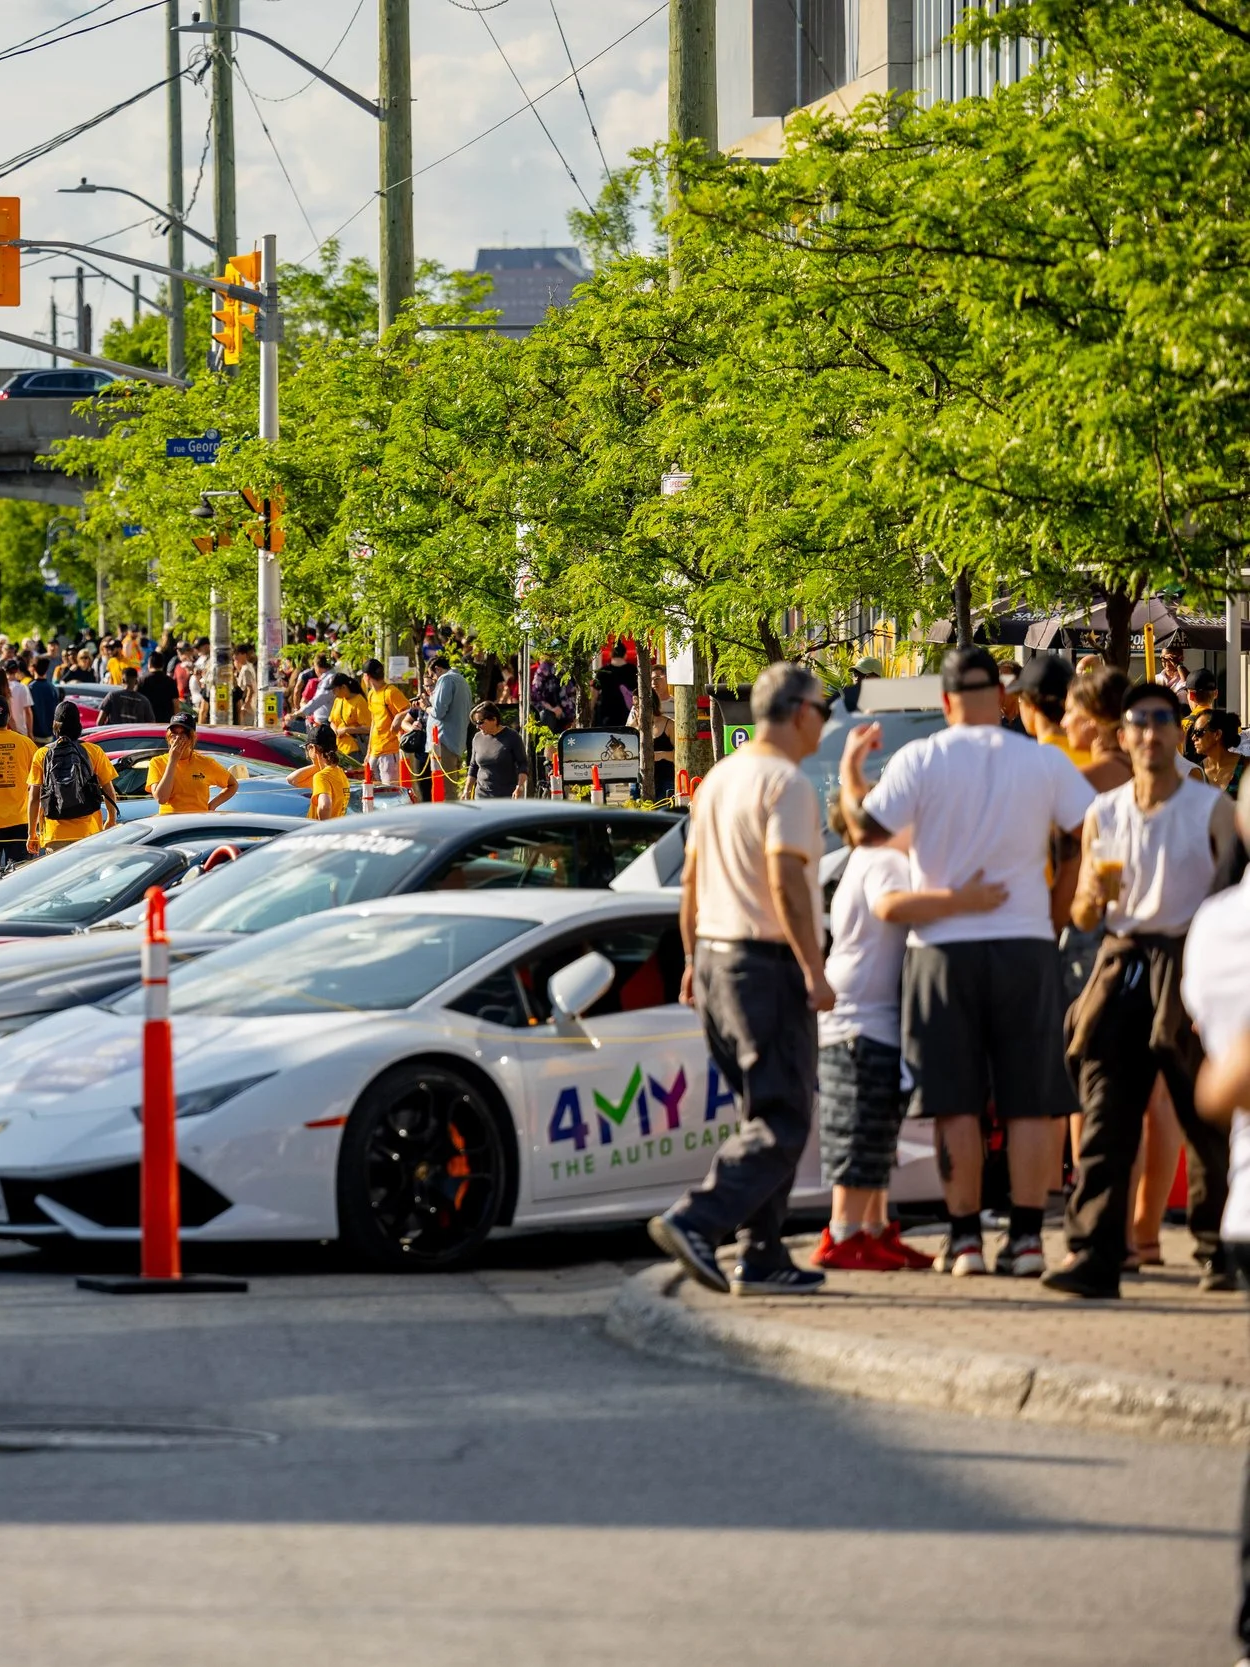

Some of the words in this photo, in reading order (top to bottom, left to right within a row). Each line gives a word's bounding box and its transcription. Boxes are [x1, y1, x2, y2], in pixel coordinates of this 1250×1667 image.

[188, 441, 219, 453] Georg
[735, 731, 746, 748] P
[550, 1158, 595, 1181] THE
[610, 1137, 672, 1169] AUTO
